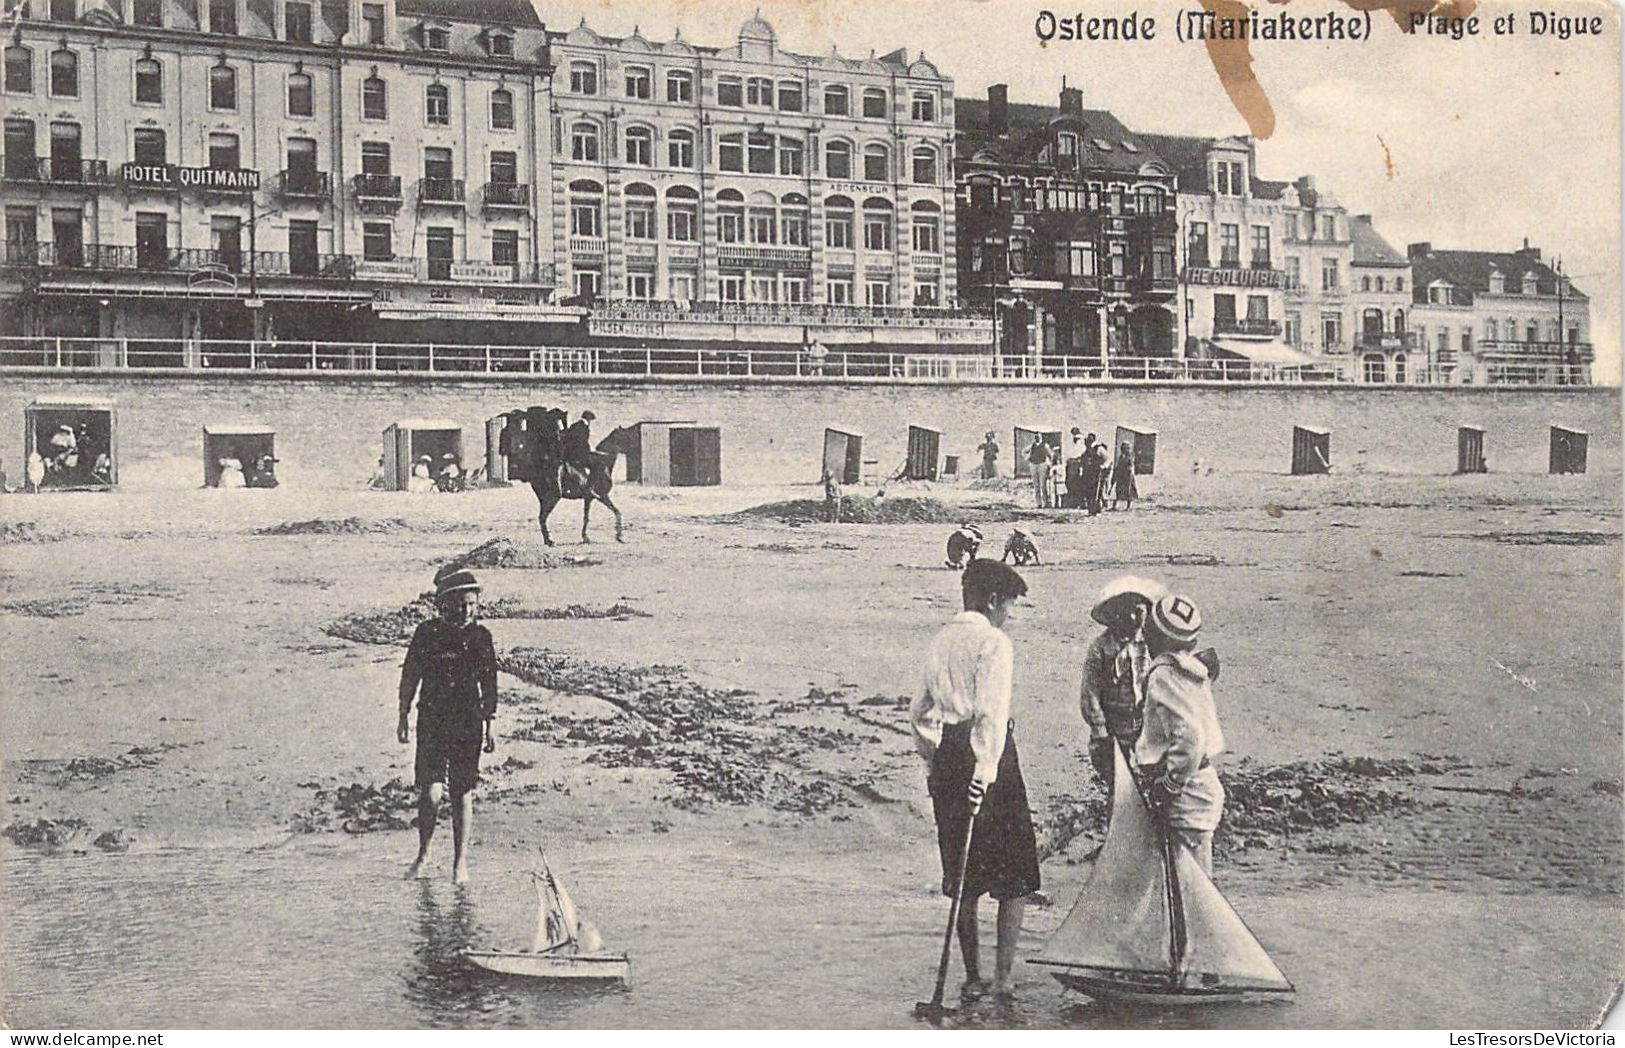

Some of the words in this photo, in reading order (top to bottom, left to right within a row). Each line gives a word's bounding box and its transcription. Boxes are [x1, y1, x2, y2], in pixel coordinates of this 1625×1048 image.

[123, 166, 171, 182] HOTEL
[180, 168, 258, 187] QUITMANN
[650, 173, 674, 181] LIFT
[1186, 267, 1212, 283] THE
